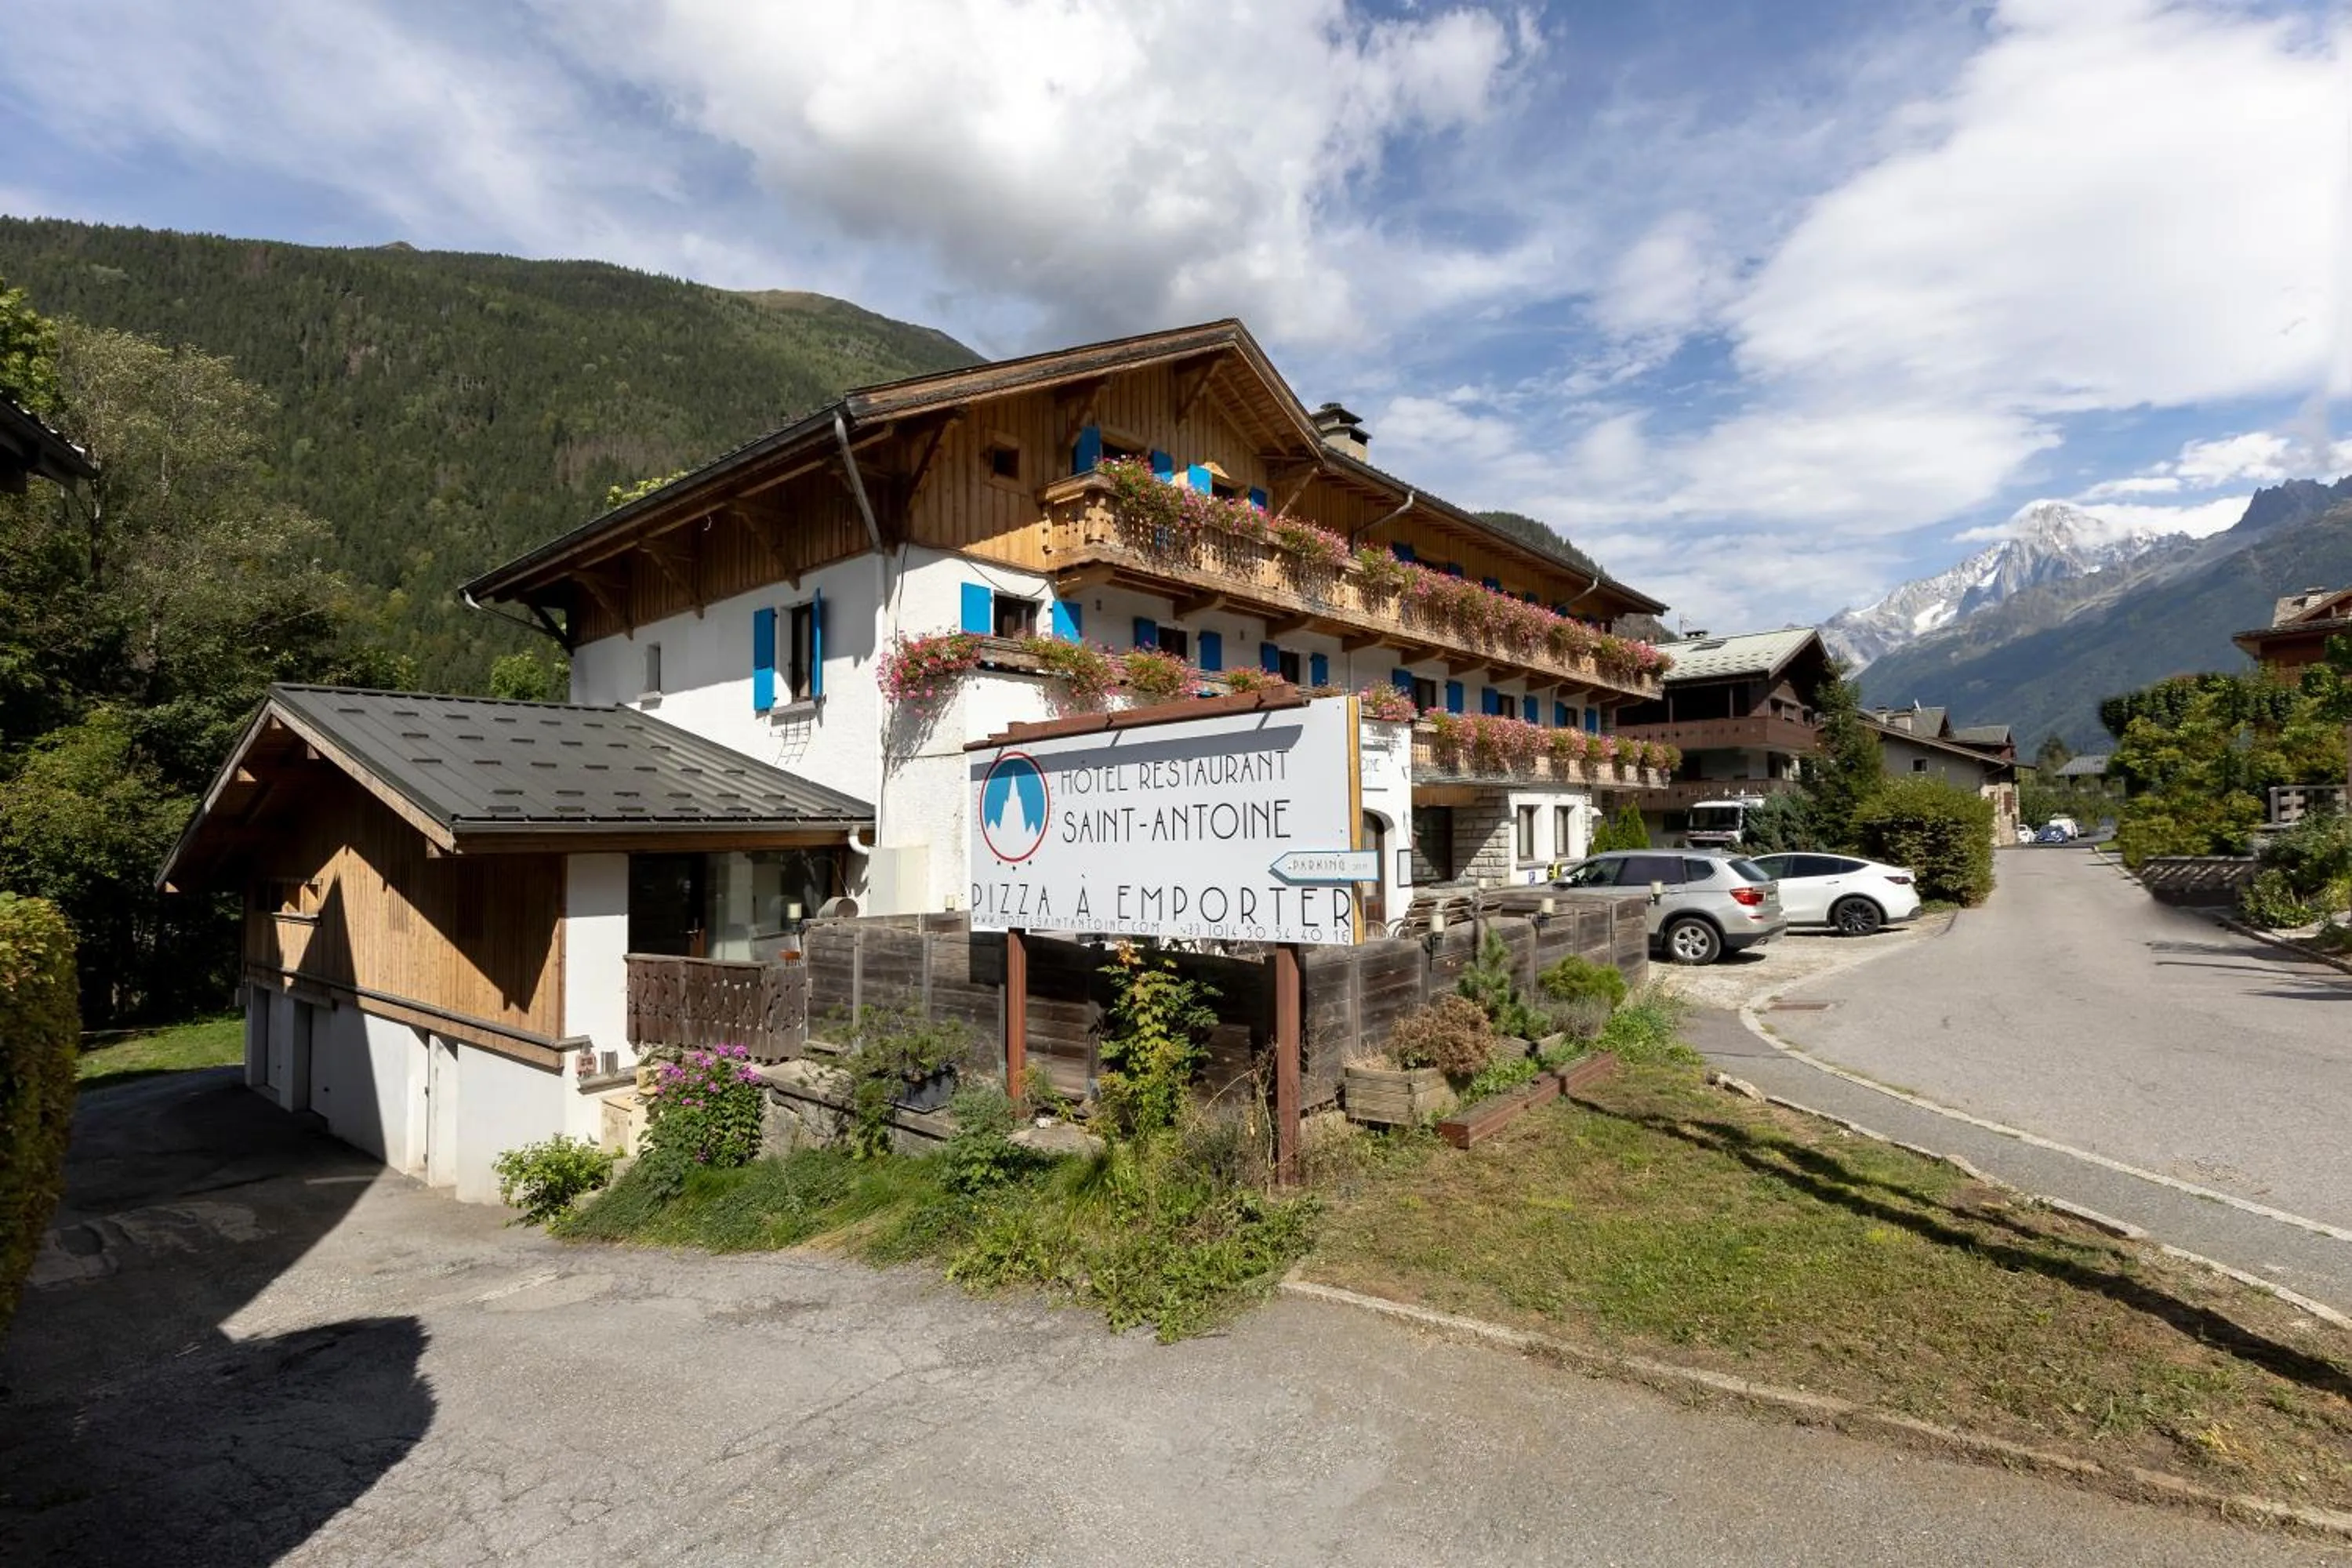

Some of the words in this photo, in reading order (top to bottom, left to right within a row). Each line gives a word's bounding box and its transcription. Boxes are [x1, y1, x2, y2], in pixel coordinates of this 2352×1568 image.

[1139, 750, 1290, 789] RESTAURANT
[1062, 799, 1291, 844] SAINT-ANTOINE
[1293, 858, 1346, 871] PARKING
[971, 882, 1051, 916] PIZZA
[1076, 873, 1091, 918] À
[1117, 884, 1351, 927] EMPORTER
